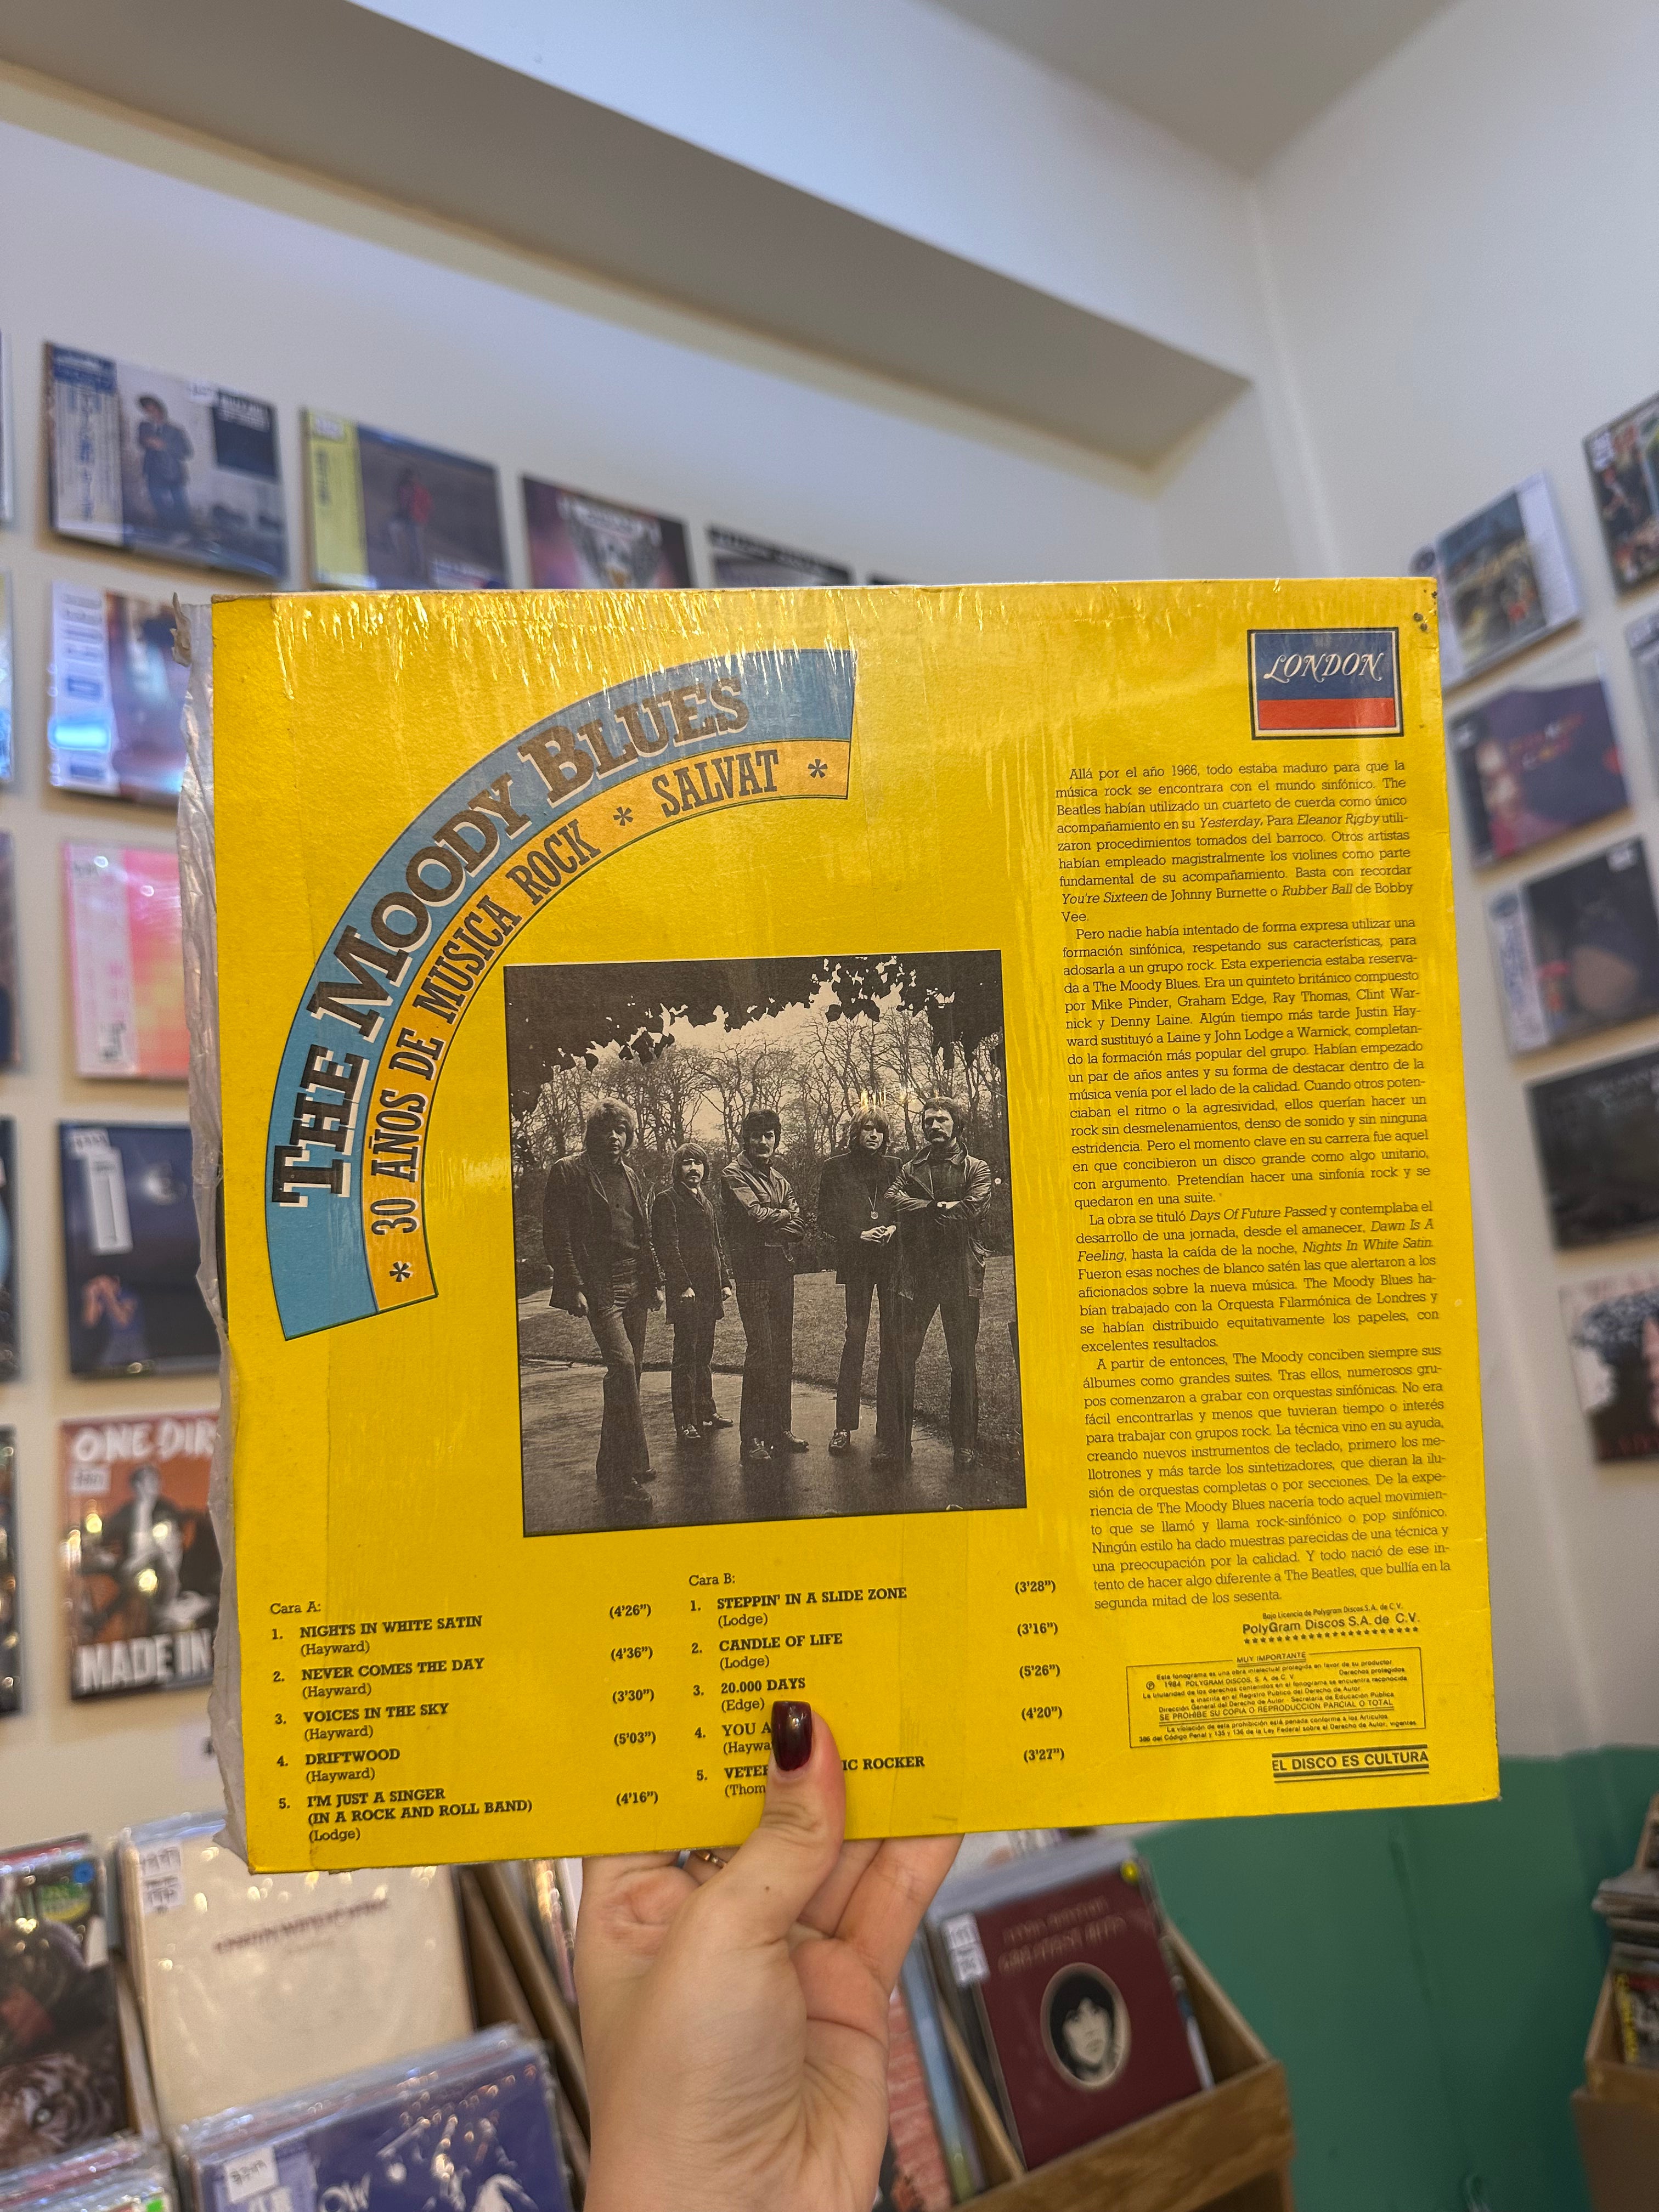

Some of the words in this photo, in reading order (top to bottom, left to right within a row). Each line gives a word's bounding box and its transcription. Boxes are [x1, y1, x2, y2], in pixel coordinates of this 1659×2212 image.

[1263, 653, 1384, 684] LONDON
[517, 677, 749, 808] BLUES
[1069, 768, 1093, 780] Allá
[1098, 770, 1119, 781] por
[1126, 766, 1137, 777] el
[1143, 766, 1164, 777] año
[1172, 764, 1199, 776] 1966,
[1206, 764, 1233, 775] todo
[1239, 763, 1278, 774] estaba
[1283, 763, 1328, 773] maduro
[1333, 764, 1360, 774] para
[1366, 763, 1389, 773] que
[1394, 760, 1404, 770] la
[652, 749, 779, 818] SALVAT
[506, 819, 602, 906] ROCK
[306, 772, 532, 1042] MOODY
[412, 894, 522, 1025] MUSICA
[1065, 1003, 1086, 1013] por
[1091, 998, 1122, 1010] Mike
[1128, 997, 1171, 1009] Pinder,
[1178, 995, 1226, 1007] Graham
[1231, 993, 1266, 1006] Edge,
[1273, 992, 1295, 1005] Ray
[1301, 991, 1351, 1002] Thomas,
[1356, 989, 1385, 1000] Clint
[1390, 988, 1419, 998] War-
[389, 1027, 446, 1081] DE
[272, 1044, 369, 1206] THE
[369, 1089, 429, 1183] AÑOS
[370, 1197, 420, 1235] 30
[1079, 1285, 1148, 1298] aficionados
[1153, 1283, 1188, 1297] sobre
[1193, 1283, 1205, 1293] la
[1210, 1283, 1247, 1293] nueva
[1252, 1279, 1297, 1291] música.
[1304, 1277, 1328, 1289] The
[1333, 1276, 1375, 1289] Moody
[1380, 1274, 1413, 1285] Blues
[1418, 1273, 1436, 1283] ha-
[71, 1422, 154, 1462] ONE
[689, 1575, 719, 1586] Cara
[724, 1573, 735, 1584] B:
[270, 1603, 302, 1615] Cara
[307, 1601, 321, 1612] A:
[691, 1600, 701, 1611] 1.
[717, 1594, 780, 1610] STEPPIN'
[785, 1593, 802, 1605] IN
[806, 1592, 817, 1604] A
[822, 1589, 864, 1602] SLIDE
[868, 1587, 907, 1600] ZONE
[1095, 1596, 1147, 1610] segunda
[1153, 1594, 1187, 1606] mitad
[1192, 1593, 1207, 1604] de
[1212, 1593, 1229, 1603] los
[1234, 1590, 1282, 1601] sesenta.
[718, 1612, 768, 1629] (Lodge)
[1243, 1622, 1301, 1635] PolyGram
[1306, 1619, 1345, 1630] Discos
[1348, 1616, 1371, 1627] S.A.
[1374, 1615, 1389, 1624] de
[1396, 1612, 1420, 1623] C.V.
[1262, 1612, 1276, 1621] Bajo
[1278, 1610, 1302, 1619] Licencia
[1313, 1608, 1342, 1617] Polygram
[1344, 1605, 1363, 1613] Discos
[272, 1628, 283, 1640] 1.
[300, 1624, 356, 1638] NIGHTS
[360, 1622, 377, 1634] IN
[382, 1619, 432, 1633] WHITE
[437, 1616, 482, 1629] SATIN
[300, 1640, 370, 1657] (Hayward)
[692, 1643, 702, 1654] 2.
[719, 1637, 780, 1651] CANDLE
[786, 1635, 805, 1647] OF
[810, 1633, 842, 1645] LIFE
[74, 1634, 173, 1693] MADE
[174, 1627, 215, 1677] IN
[720, 1655, 769, 1672] (Lodge)
[1257, 1652, 1306, 1662] IMPORTANTE
[273, 1671, 285, 1683] 2.
[302, 1667, 354, 1680] NEVER
[358, 1663, 413, 1677] COMES
[417, 1661, 447, 1673] THE
[452, 1658, 484, 1671] DAY
[302, 1683, 371, 1700] (Hayward)
[693, 1685, 704, 1696] 3.
[721, 1680, 762, 1694] 20.000
[766, 1677, 805, 1691] DAYS
[275, 1713, 286, 1725] 3.
[303, 1708, 360, 1723] VOICES
[364, 1707, 381, 1719] IN
[386, 1705, 416, 1718] THE
[420, 1703, 449, 1716] SKY
[721, 1697, 765, 1713] (Edge)
[1172, 1711, 1207, 1719] PROHIBE
[1223, 1708, 1246, 1716] COPIA
[1257, 1703, 1321, 1713] REPRODUCCION
[304, 1725, 374, 1742] (Hayward)
[695, 1727, 706, 1739] 4.
[722, 1723, 755, 1736] YOU
[276, 1756, 288, 1767] 4.
[304, 1748, 400, 1765] DRIFTWOOD
[723, 1741, 772, 1756] (Haywa
[697, 1769, 708, 1781] 5.
[863, 1756, 925, 1770] ROCKER
[1272, 1760, 1287, 1771] EL
[1292, 1756, 1337, 1770] DISCO
[1342, 1755, 1359, 1767] ES
[1364, 1752, 1429, 1765] CULTURA
[305, 1767, 375, 1785] (Hayward)
[278, 1797, 290, 1809] 5.
[308, 1795, 331, 1807] I'M
[336, 1793, 368, 1807] JUST
[373, 1792, 385, 1803] A
[390, 1788, 445, 1802] SINGER
[308, 1812, 330, 1826] (IN
[335, 1812, 347, 1823] A
[352, 1808, 396, 1822] ROCK
[400, 1806, 434, 1819] AND
[439, 1803, 479, 1816] ROLL
[484, 1800, 532, 1813] BAND)
[308, 1827, 360, 1844] (Lodge)
